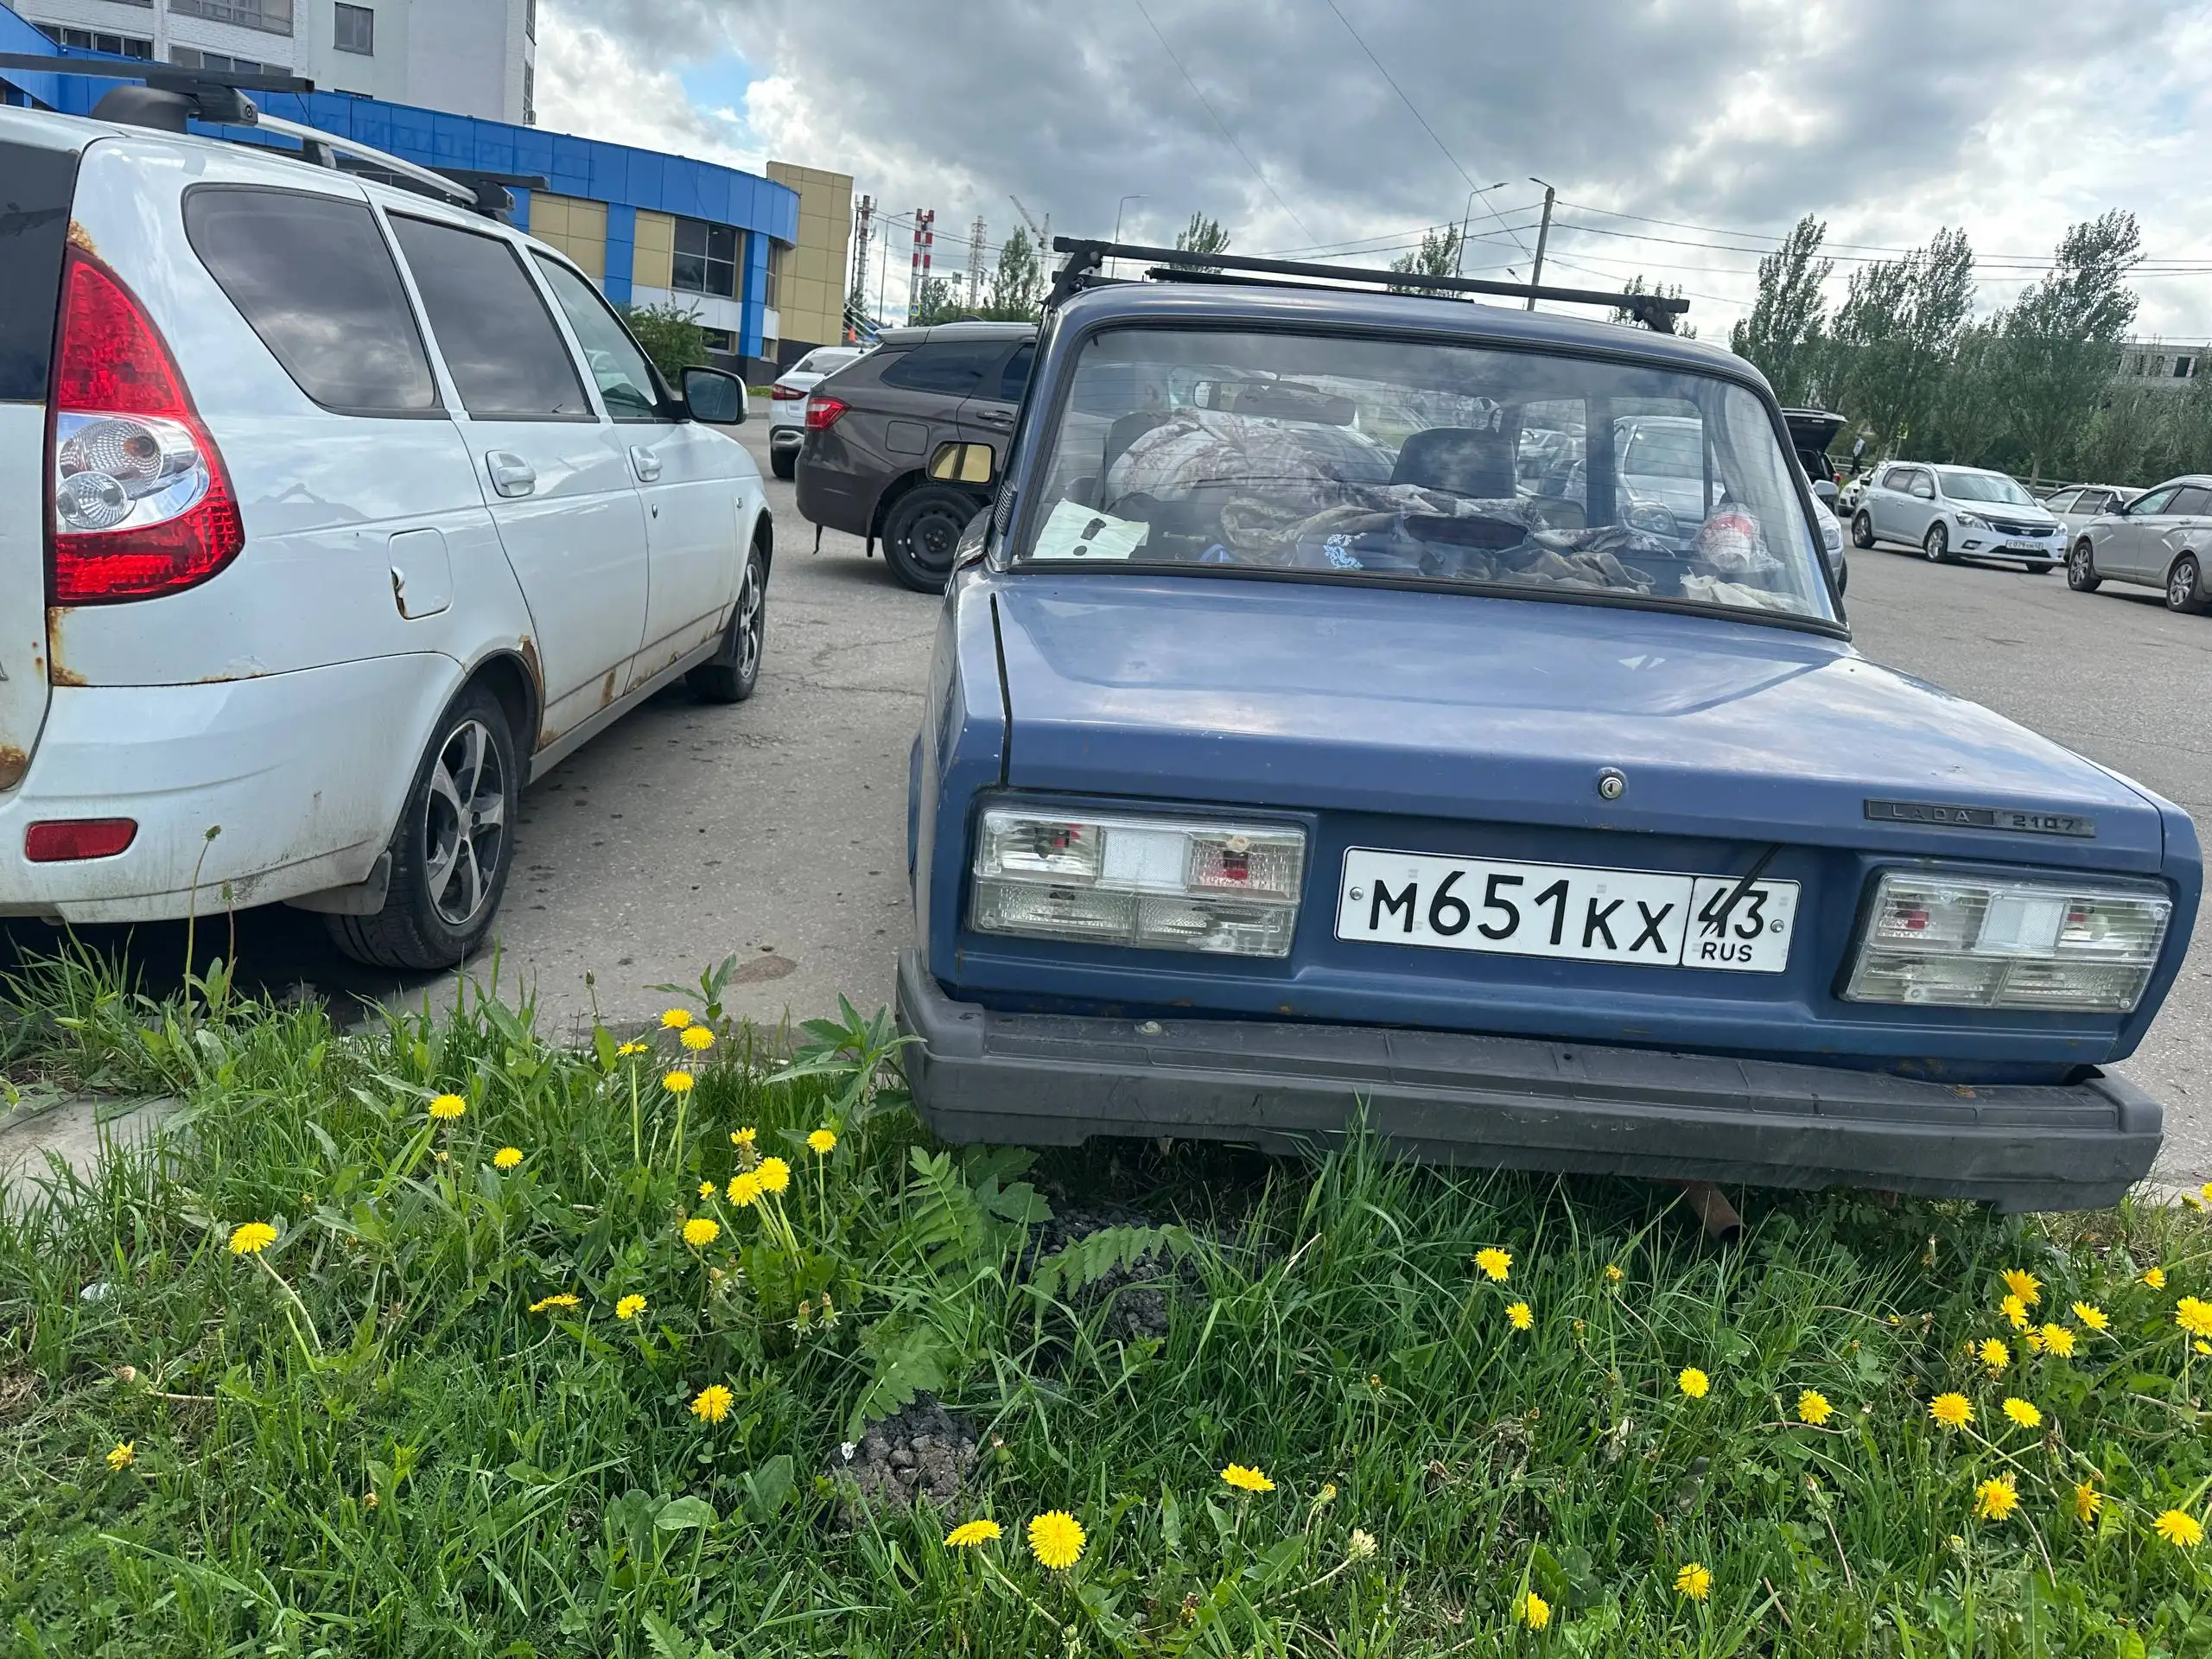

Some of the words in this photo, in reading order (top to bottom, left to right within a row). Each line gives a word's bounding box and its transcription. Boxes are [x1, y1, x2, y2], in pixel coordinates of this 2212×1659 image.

[1891, 804, 1971, 823] LADA
[2012, 815, 2075, 831] 2107
[1369, 871, 1675, 953] М651КХ
[1698, 887, 1769, 939] 43
[1700, 943, 1752, 963] RUS
